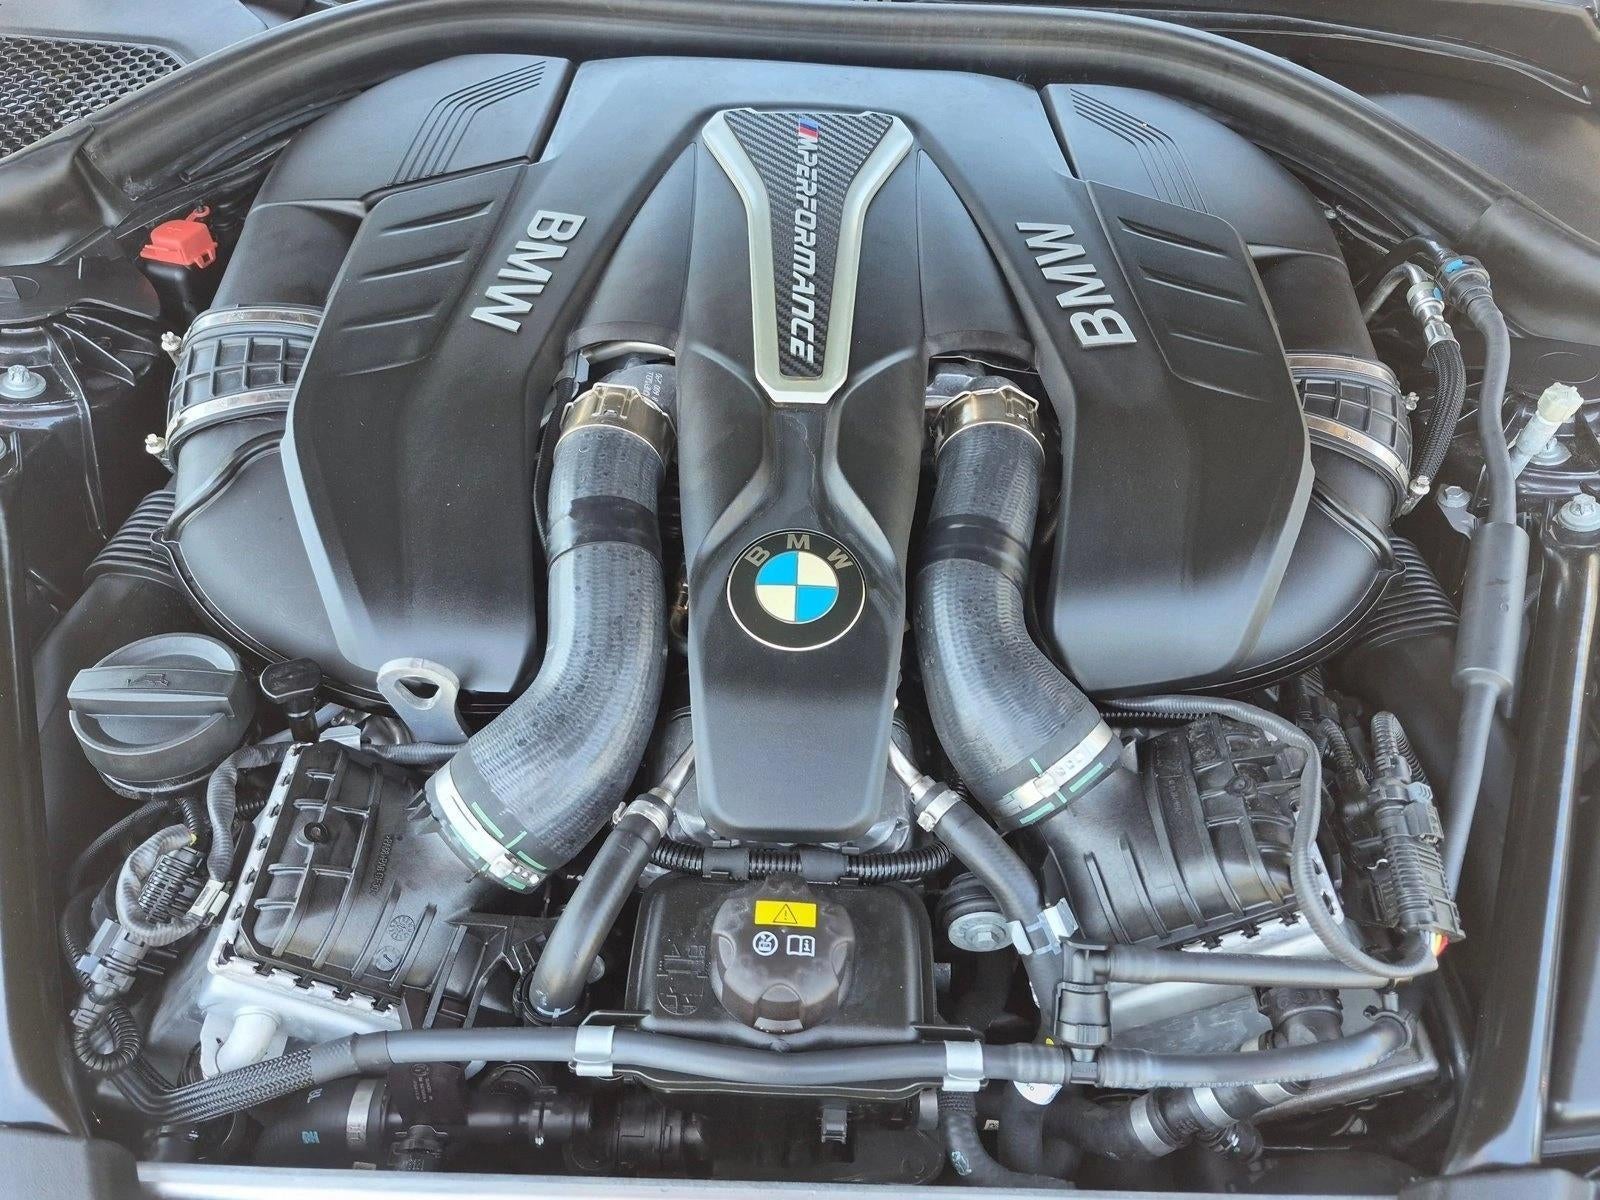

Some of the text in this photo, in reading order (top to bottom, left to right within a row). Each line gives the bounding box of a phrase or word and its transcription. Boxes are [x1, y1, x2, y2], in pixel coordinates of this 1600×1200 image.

[470, 209, 587, 333] BMW
[790, 150, 818, 364] PERFORMANCE
[1015, 221, 1138, 346] BMW
[744, 533, 854, 570] BMW
